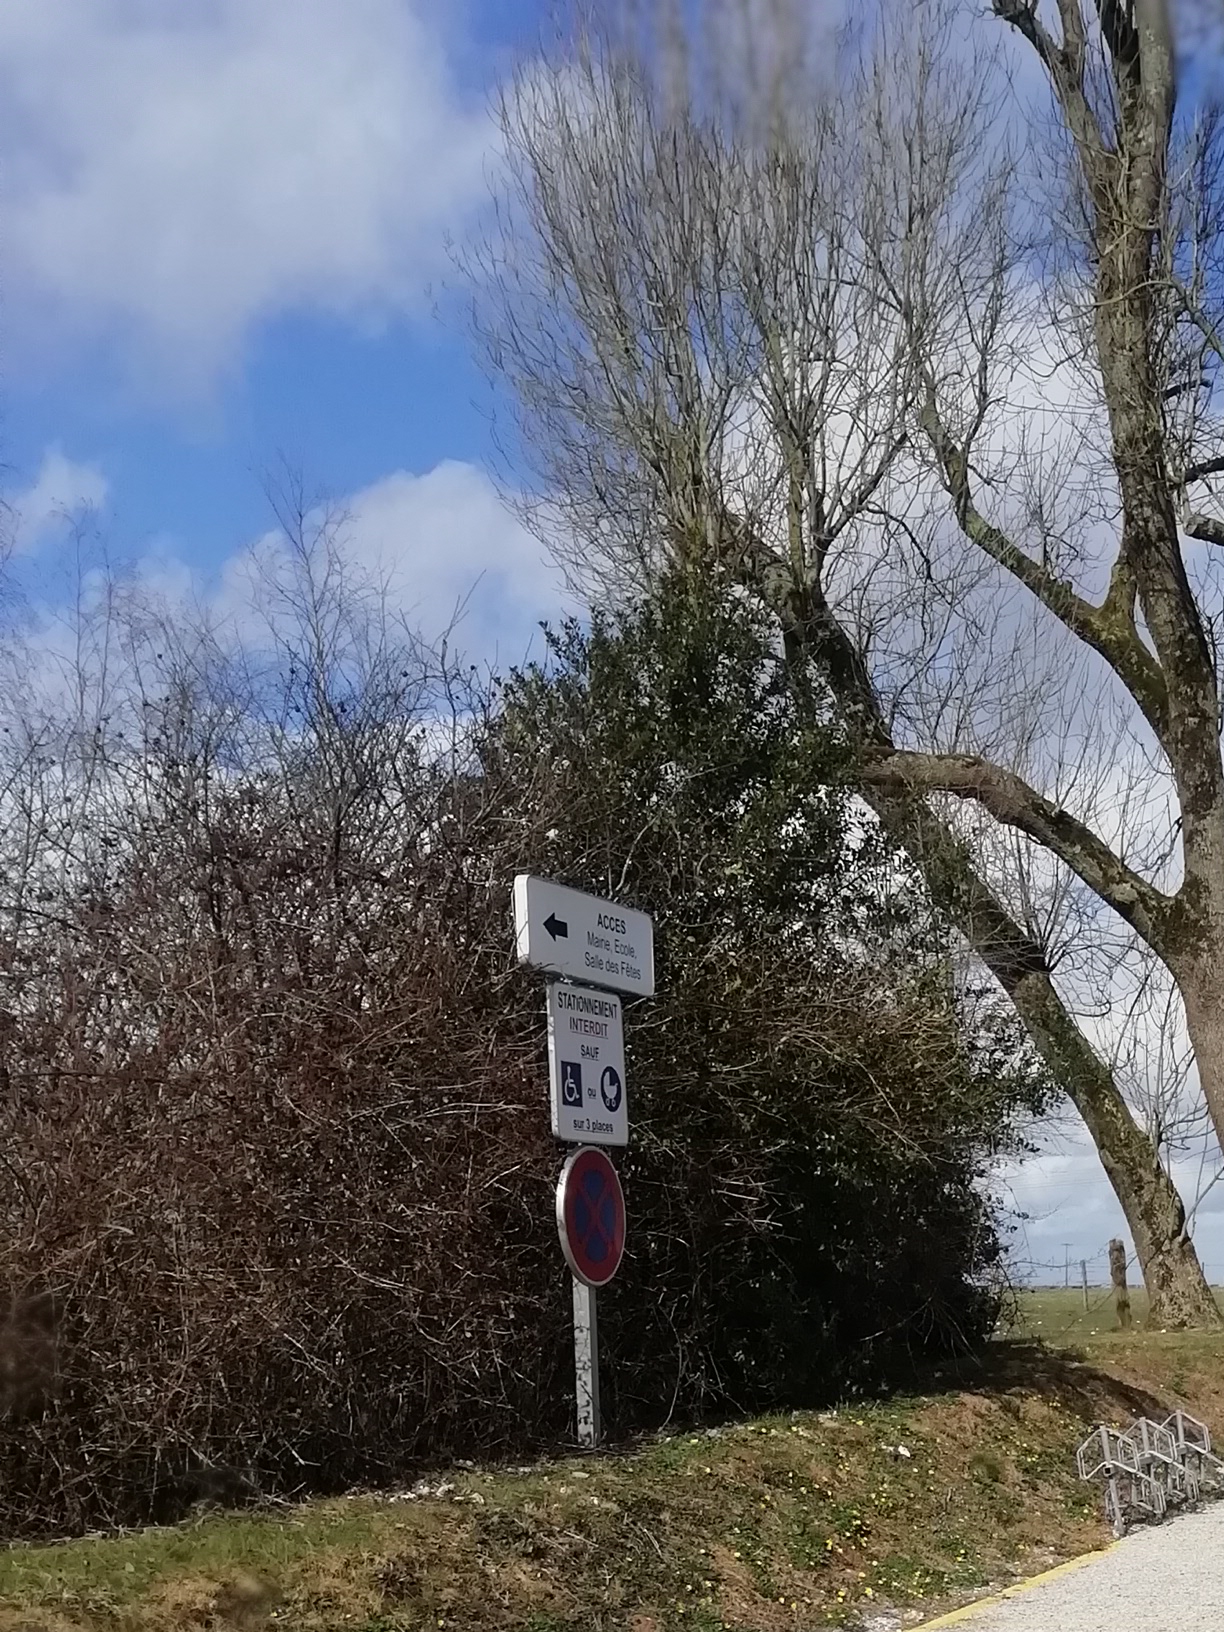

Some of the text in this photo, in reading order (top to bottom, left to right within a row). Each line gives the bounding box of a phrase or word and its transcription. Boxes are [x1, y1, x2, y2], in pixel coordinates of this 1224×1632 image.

[597, 913, 627, 935] ACCES
[584, 952, 642, 980] Salle des Fêtes
[558, 991, 618, 1020] STATIONNEMENT
[569, 1016, 609, 1037] INTERDIT
[580, 1044, 600, 1059] SAUF
[587, 1088, 597, 1098] ou
[573, 1118, 585, 1130] sur
[592, 1119, 614, 1133] places
